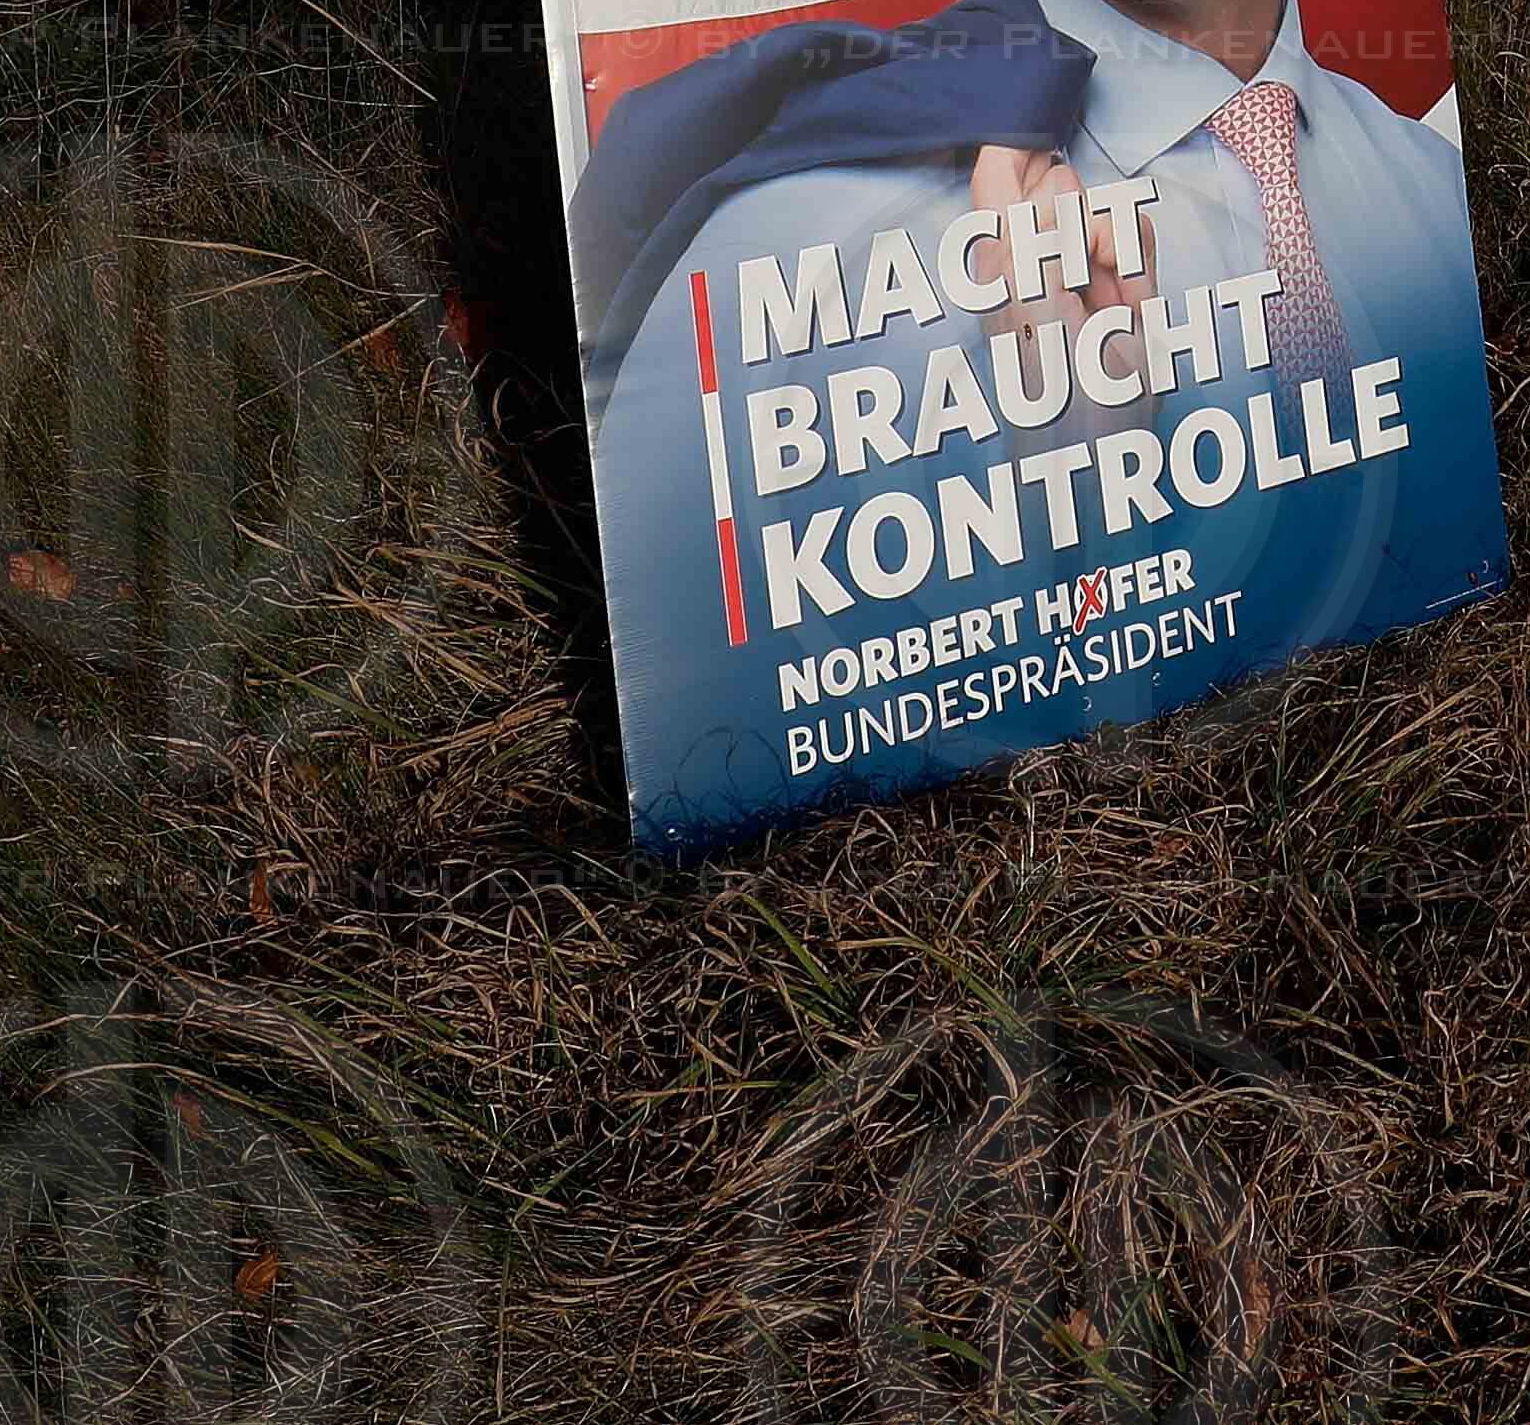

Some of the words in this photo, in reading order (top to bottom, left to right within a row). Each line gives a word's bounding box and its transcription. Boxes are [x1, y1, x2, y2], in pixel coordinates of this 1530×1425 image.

[738, 176, 1161, 366] MACHT
[747, 267, 1283, 498] BRAUCHT
[762, 356, 1412, 632] KONTROLLE
[778, 596, 1022, 712] NORBERT
[786, 590, 1244, 779] BUNDESPRÄSIDENT
